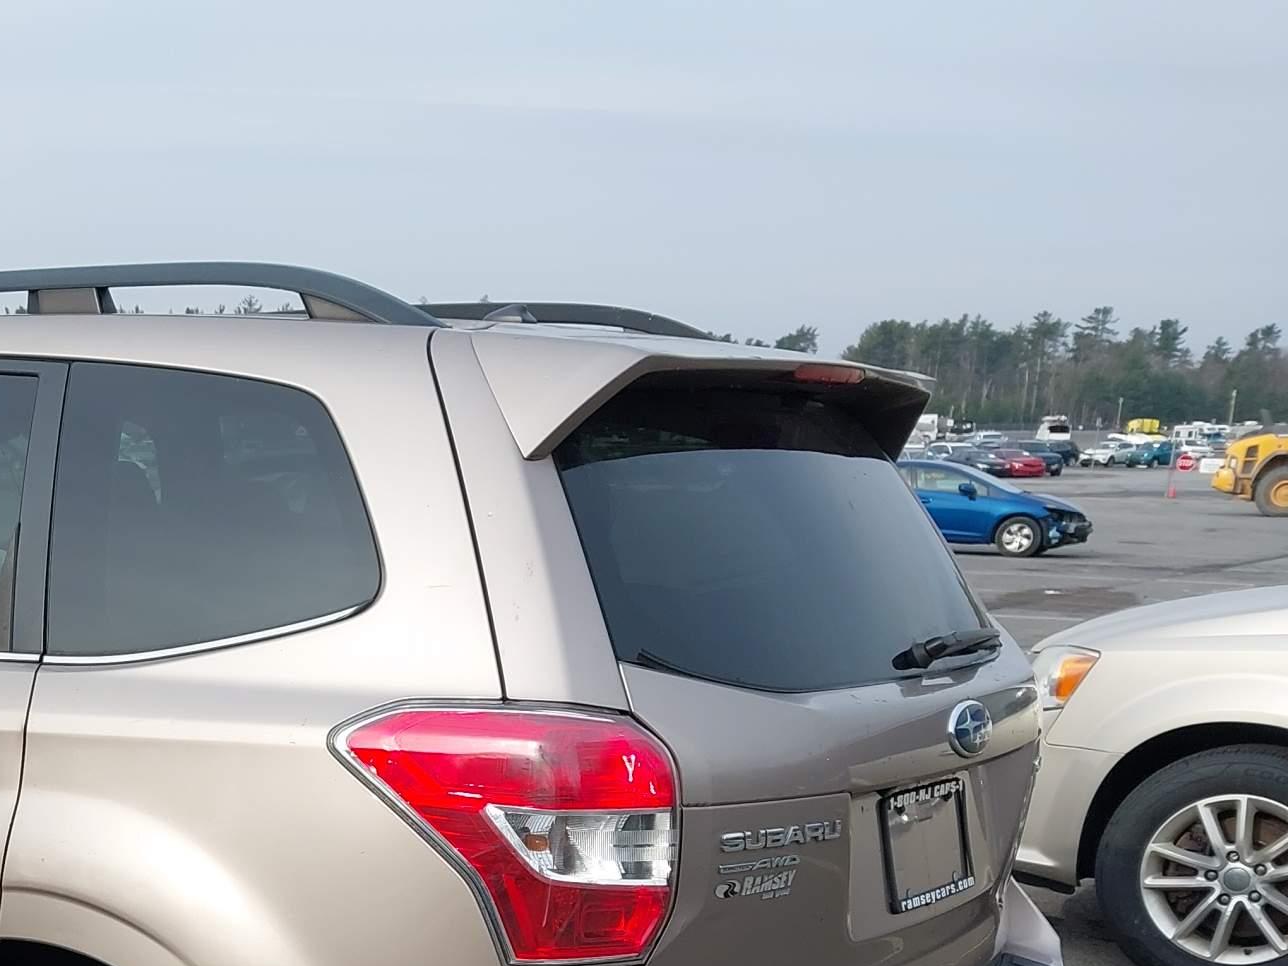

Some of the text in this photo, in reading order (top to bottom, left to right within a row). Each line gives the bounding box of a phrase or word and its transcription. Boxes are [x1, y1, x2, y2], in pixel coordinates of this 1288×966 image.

[720, 819, 841, 853] SUBARU
[752, 854, 801, 871] AWD
[741, 869, 797, 897] RAMSEY
[900, 876, 975, 912] ramseycars.com
